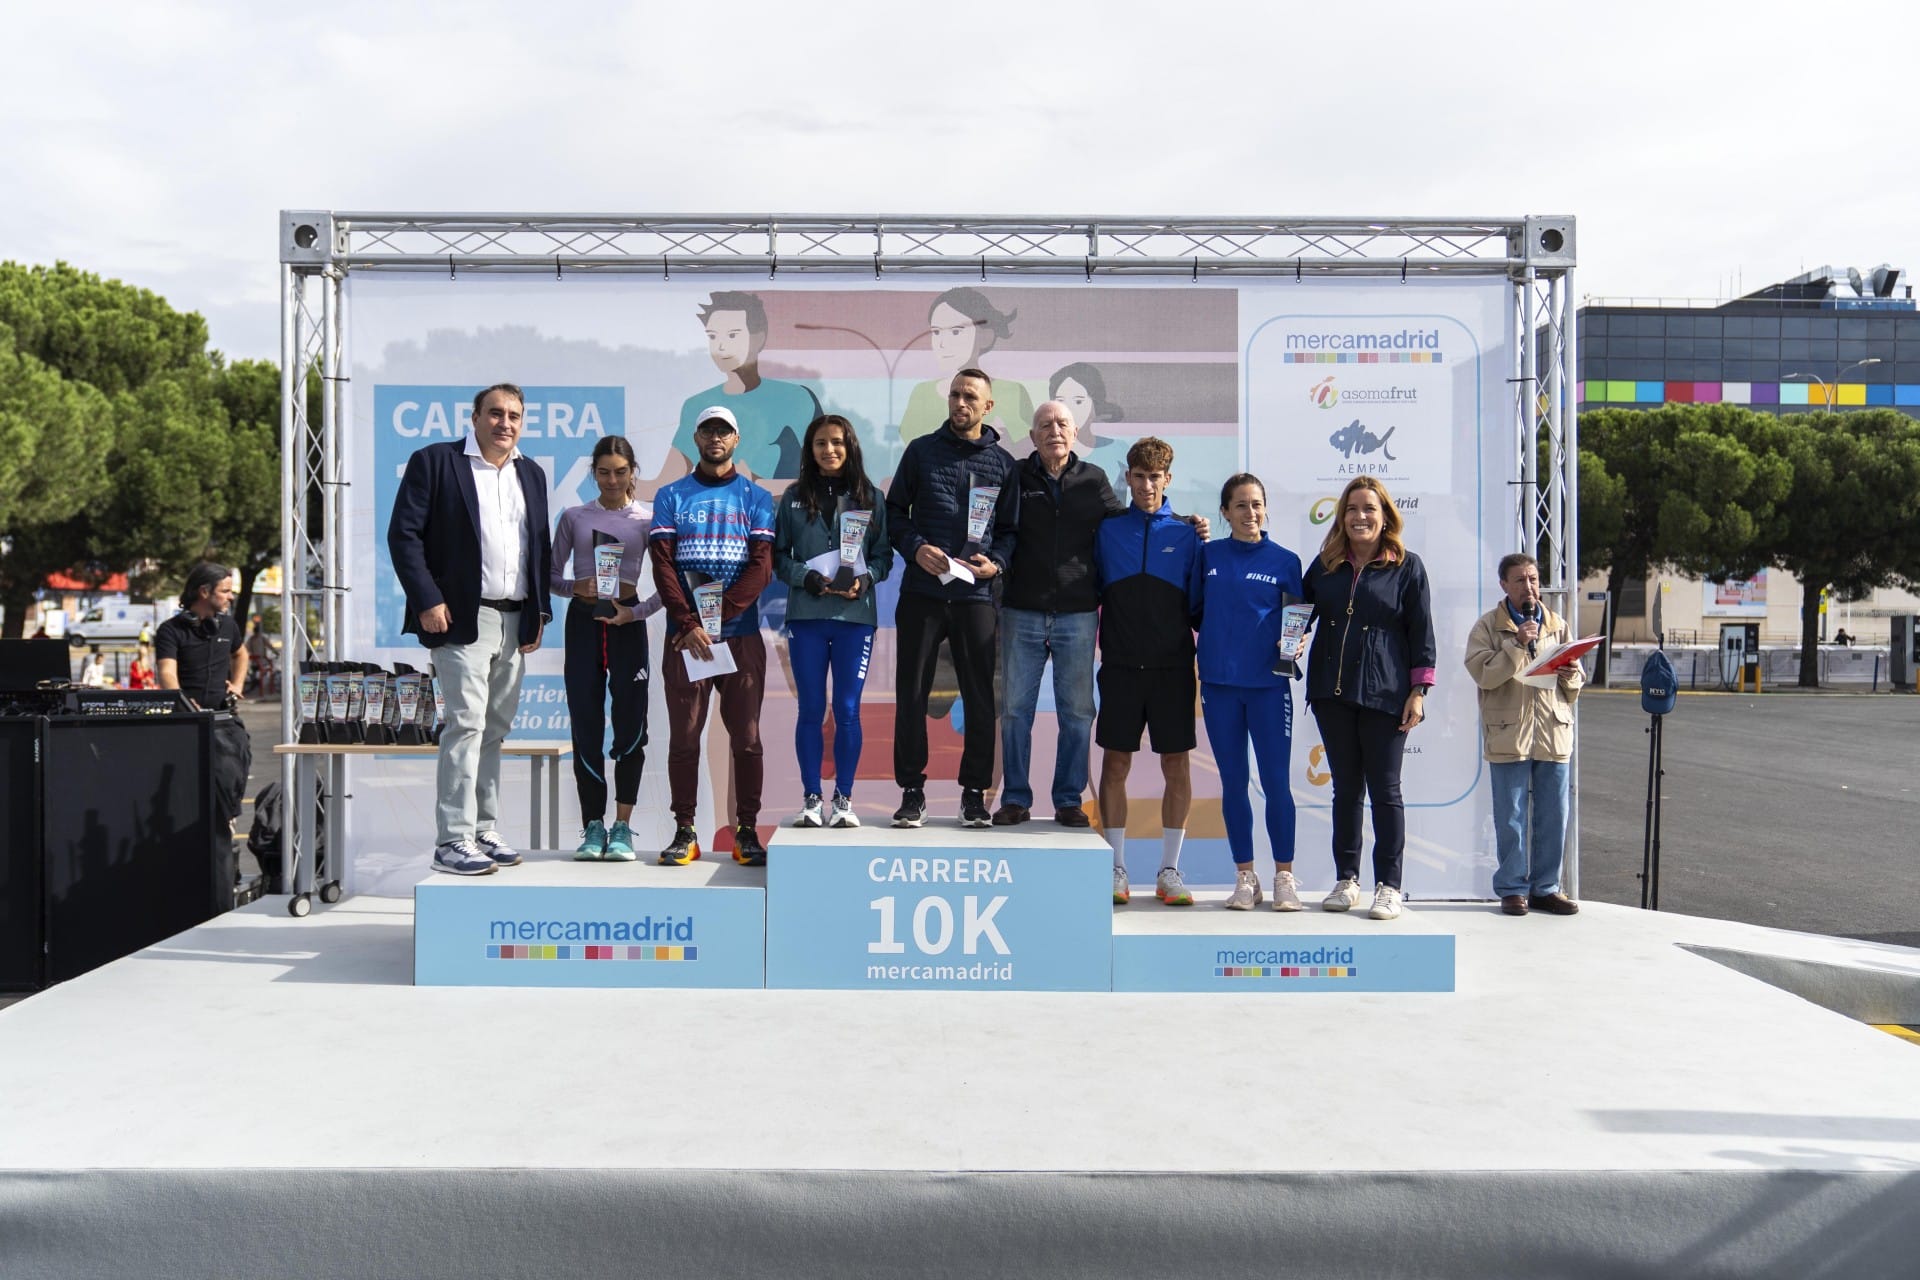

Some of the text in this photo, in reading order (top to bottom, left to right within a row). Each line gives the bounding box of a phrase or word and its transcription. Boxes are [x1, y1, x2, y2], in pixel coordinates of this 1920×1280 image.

[1286, 330, 1439, 349] mercamadrid
[1341, 386, 1417, 400] asomafrut
[392, 401, 606, 438] CARERA
[1338, 463, 1388, 473] AEMPM
[1394, 497, 1419, 509] drid
[857, 635, 872, 681] BIKILA
[868, 857, 1013, 883] CARRERA
[490, 916, 693, 941] mercamadrid
[868, 895, 1011, 955] 10K
[1217, 947, 1353, 964] mercamadrid
[867, 962, 1013, 981] mercamadrid
